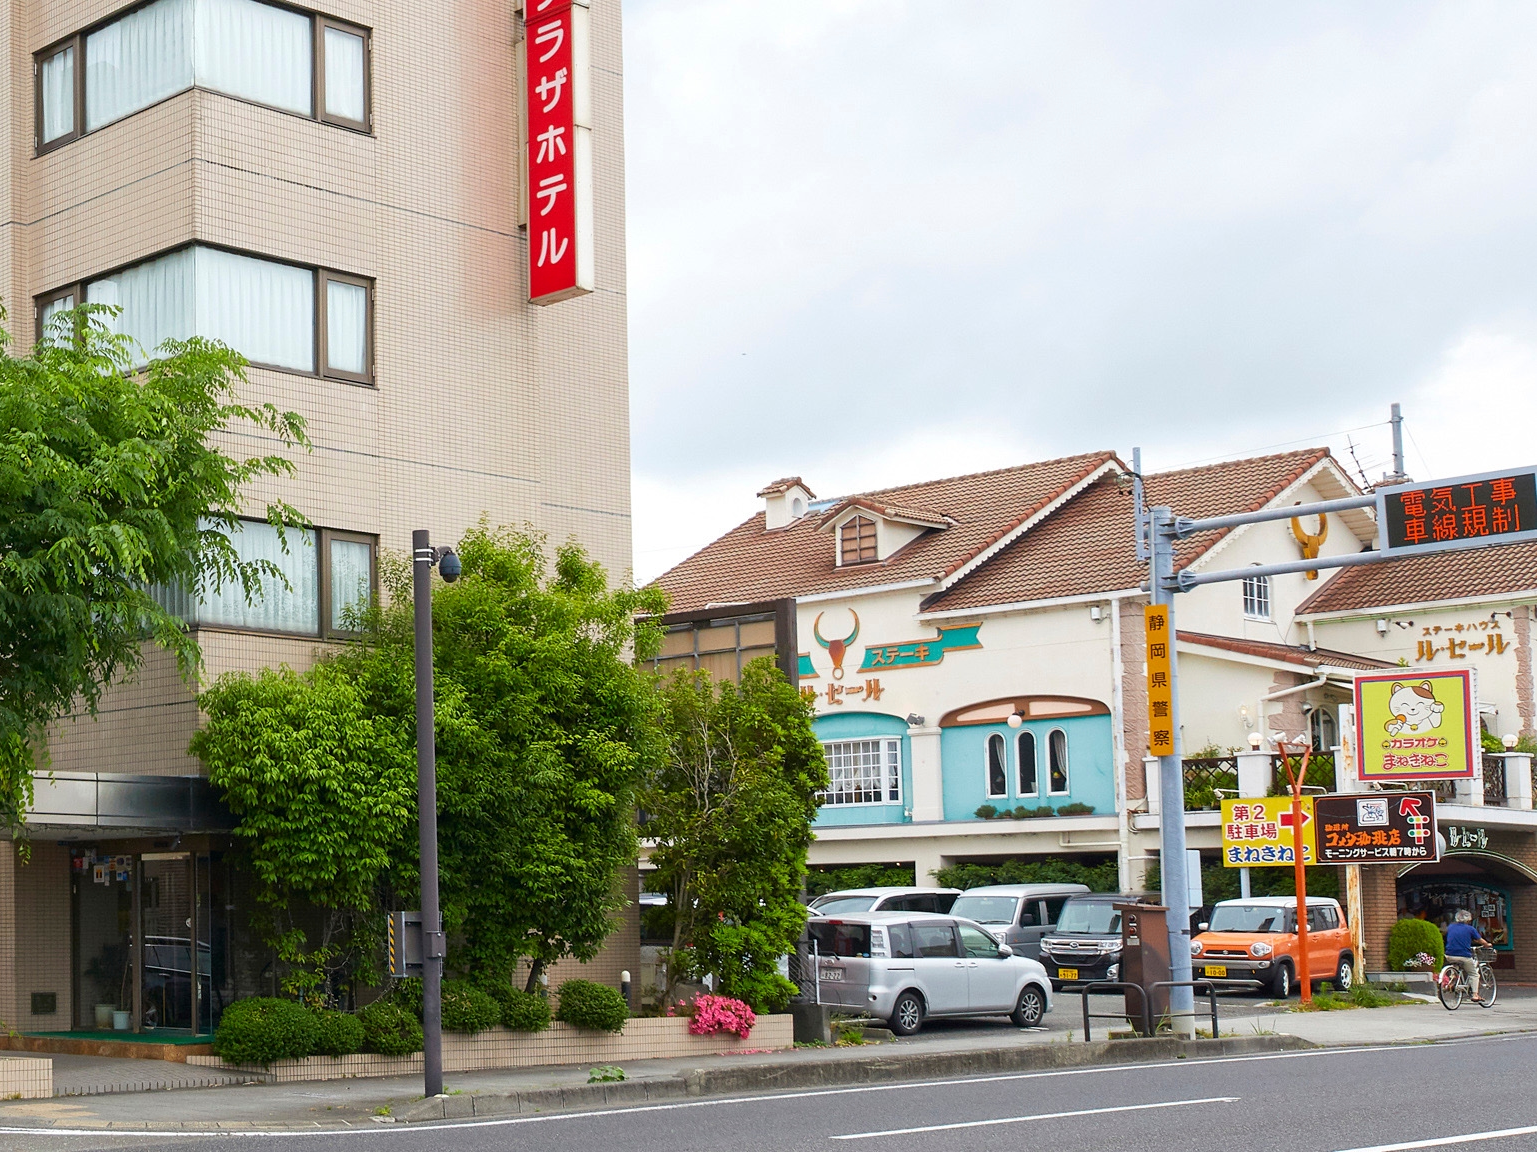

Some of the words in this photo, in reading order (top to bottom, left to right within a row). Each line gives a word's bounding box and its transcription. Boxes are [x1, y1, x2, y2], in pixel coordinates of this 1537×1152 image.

[1400, 478, 1517, 517] 電気工事
[1404, 505, 1520, 544] 車線規制
[1422, 620, 1501, 636] ステーキハウス
[872, 644, 930, 666] ステーキ
[1148, 614, 1170, 746] 静岡県警察
[1390, 737, 1439, 749] カラオケ
[1382, 753, 1448, 770] まねきねこ
[1226, 823, 1278, 840] 駐車場
[1325, 828, 1401, 847] コメダ珈琲店
